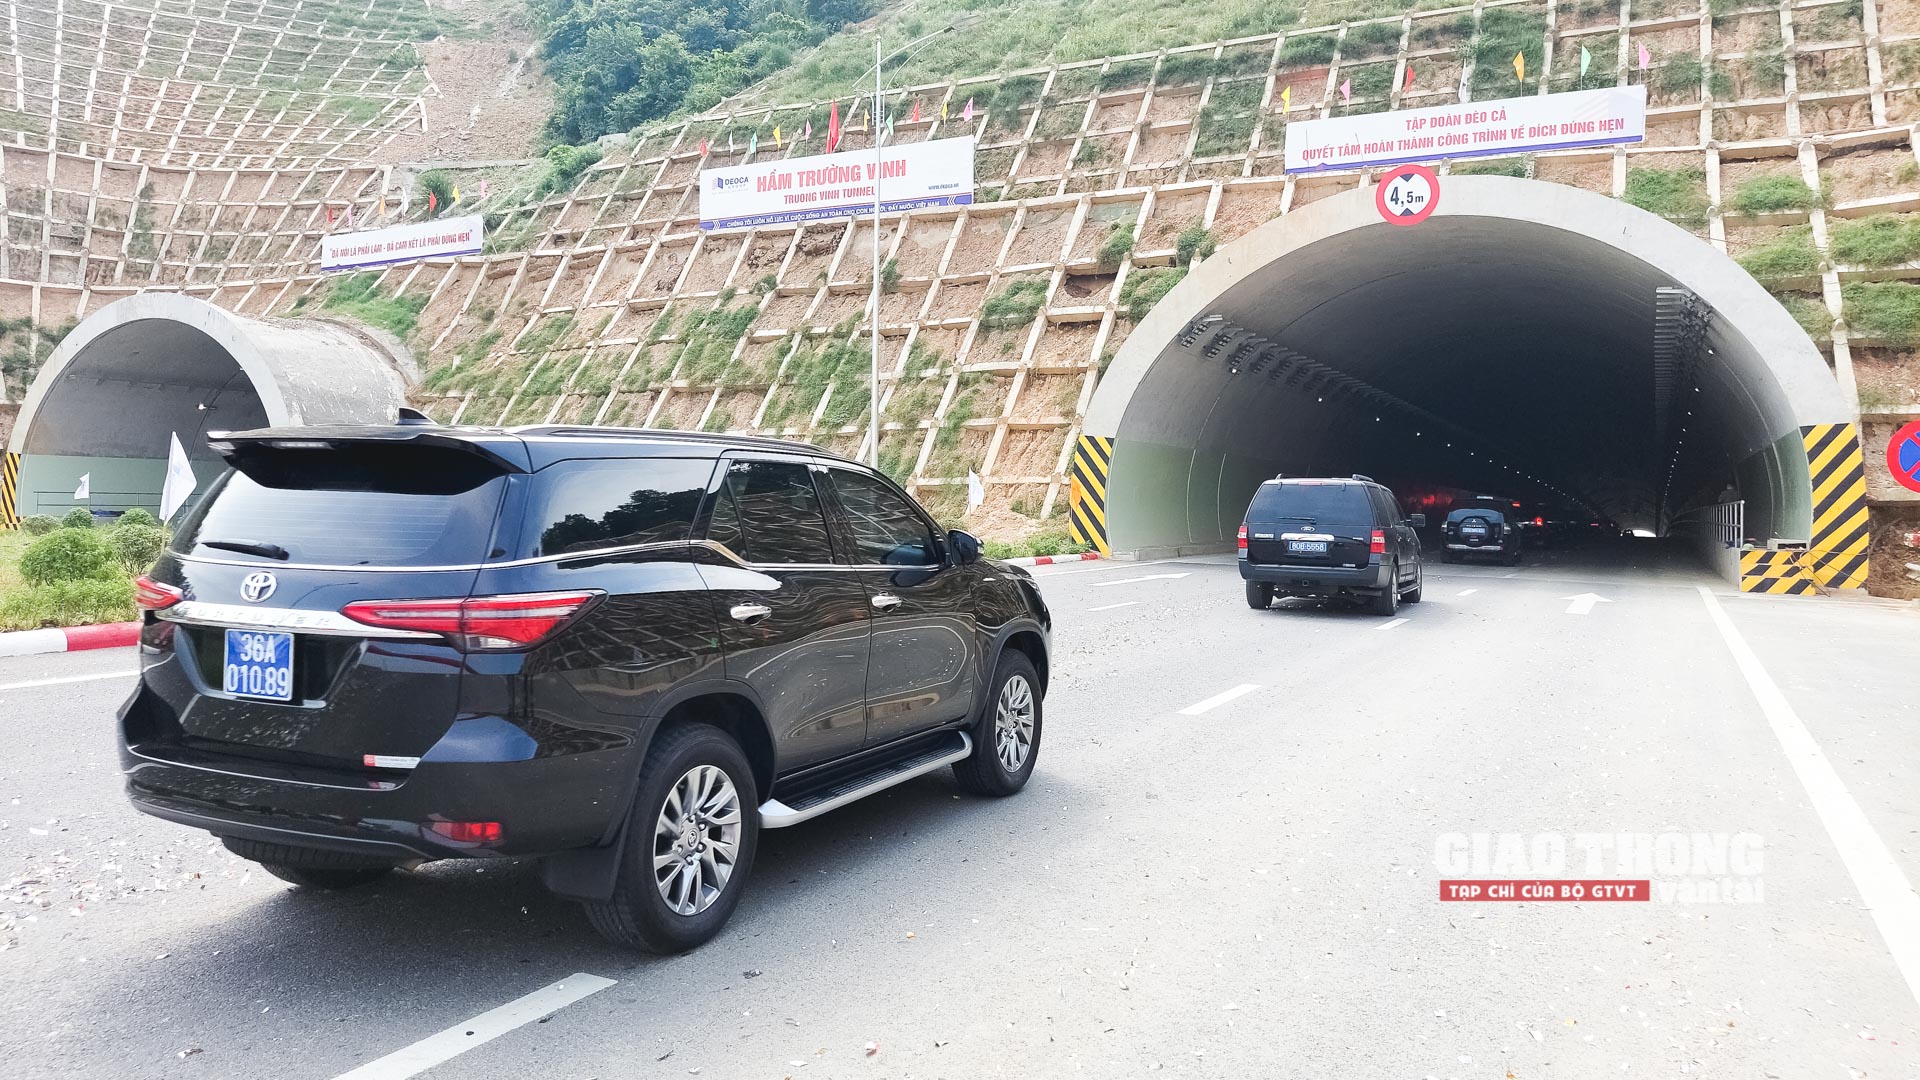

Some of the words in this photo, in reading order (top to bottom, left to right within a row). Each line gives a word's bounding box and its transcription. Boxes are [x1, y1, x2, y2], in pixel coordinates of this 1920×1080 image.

[1406, 117, 1426, 132] TẬP
[1430, 113, 1461, 128] ĐOÀN
[1465, 109, 1487, 124] ĐÈO
[1491, 106, 1507, 122] CẢ
[1302, 143, 1335, 161] QUYẾT
[1337, 143, 1361, 157] TÂM
[1363, 140, 1394, 154] HOÀN
[1397, 136, 1434, 151] THÀNH
[1437, 132, 1469, 147] CÔNG
[1472, 128, 1507, 143] TRÌNH
[1528, 122, 1557, 138] ĐÍCH
[1561, 120, 1595, 135] ĐÚNG
[1598, 117, 1624, 134] HẸN
[724, 176, 749, 186] DEOCA
[756, 169, 792, 192] HẦM
[797, 163, 861, 188] TRƯỜNG
[784, 192, 817, 204] TRUONG
[819, 189, 840, 200] VINH
[843, 186, 876, 198] TUNNEL
[240, 633, 276, 664] 36A
[227, 664, 288, 696] 010.89
